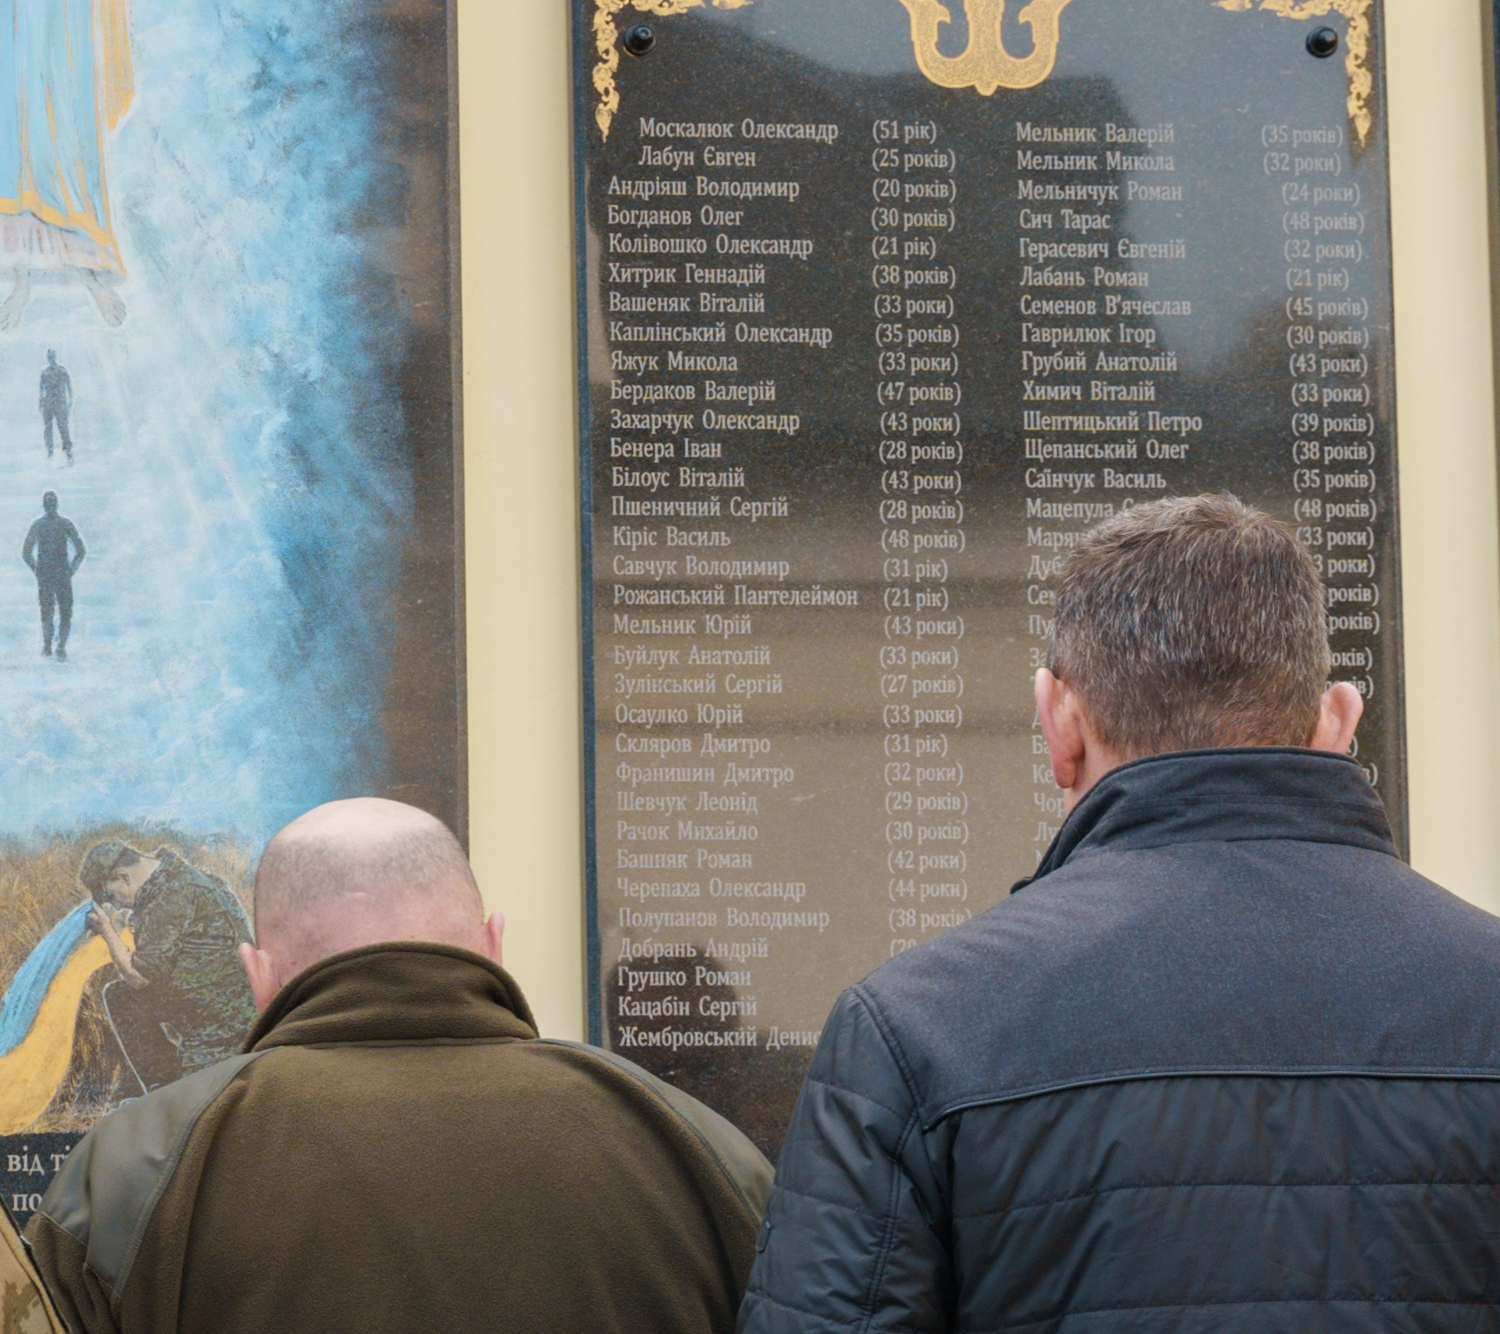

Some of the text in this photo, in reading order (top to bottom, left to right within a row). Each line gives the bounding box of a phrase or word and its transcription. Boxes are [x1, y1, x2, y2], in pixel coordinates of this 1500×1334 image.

[638, 117, 937, 144] Москалюк Олександр (51 рік)
[638, 145, 955, 171] Лабун Євген (25 років)
[1019, 209, 1365, 234] Сич Тарас (48 років)
[608, 263, 956, 288] Хитрик Геннадій (38 років)
[1020, 322, 1369, 348] Гаврилюк Ігор (30 років)
[610, 380, 961, 405] Бердаков Валерій (47 років)
[613, 585, 948, 611] Рожанський Пантелеймон (21 рік)
[616, 791, 968, 816] Шевчук Леонід (29 років)
[6, 1145, 45, 1176] від
